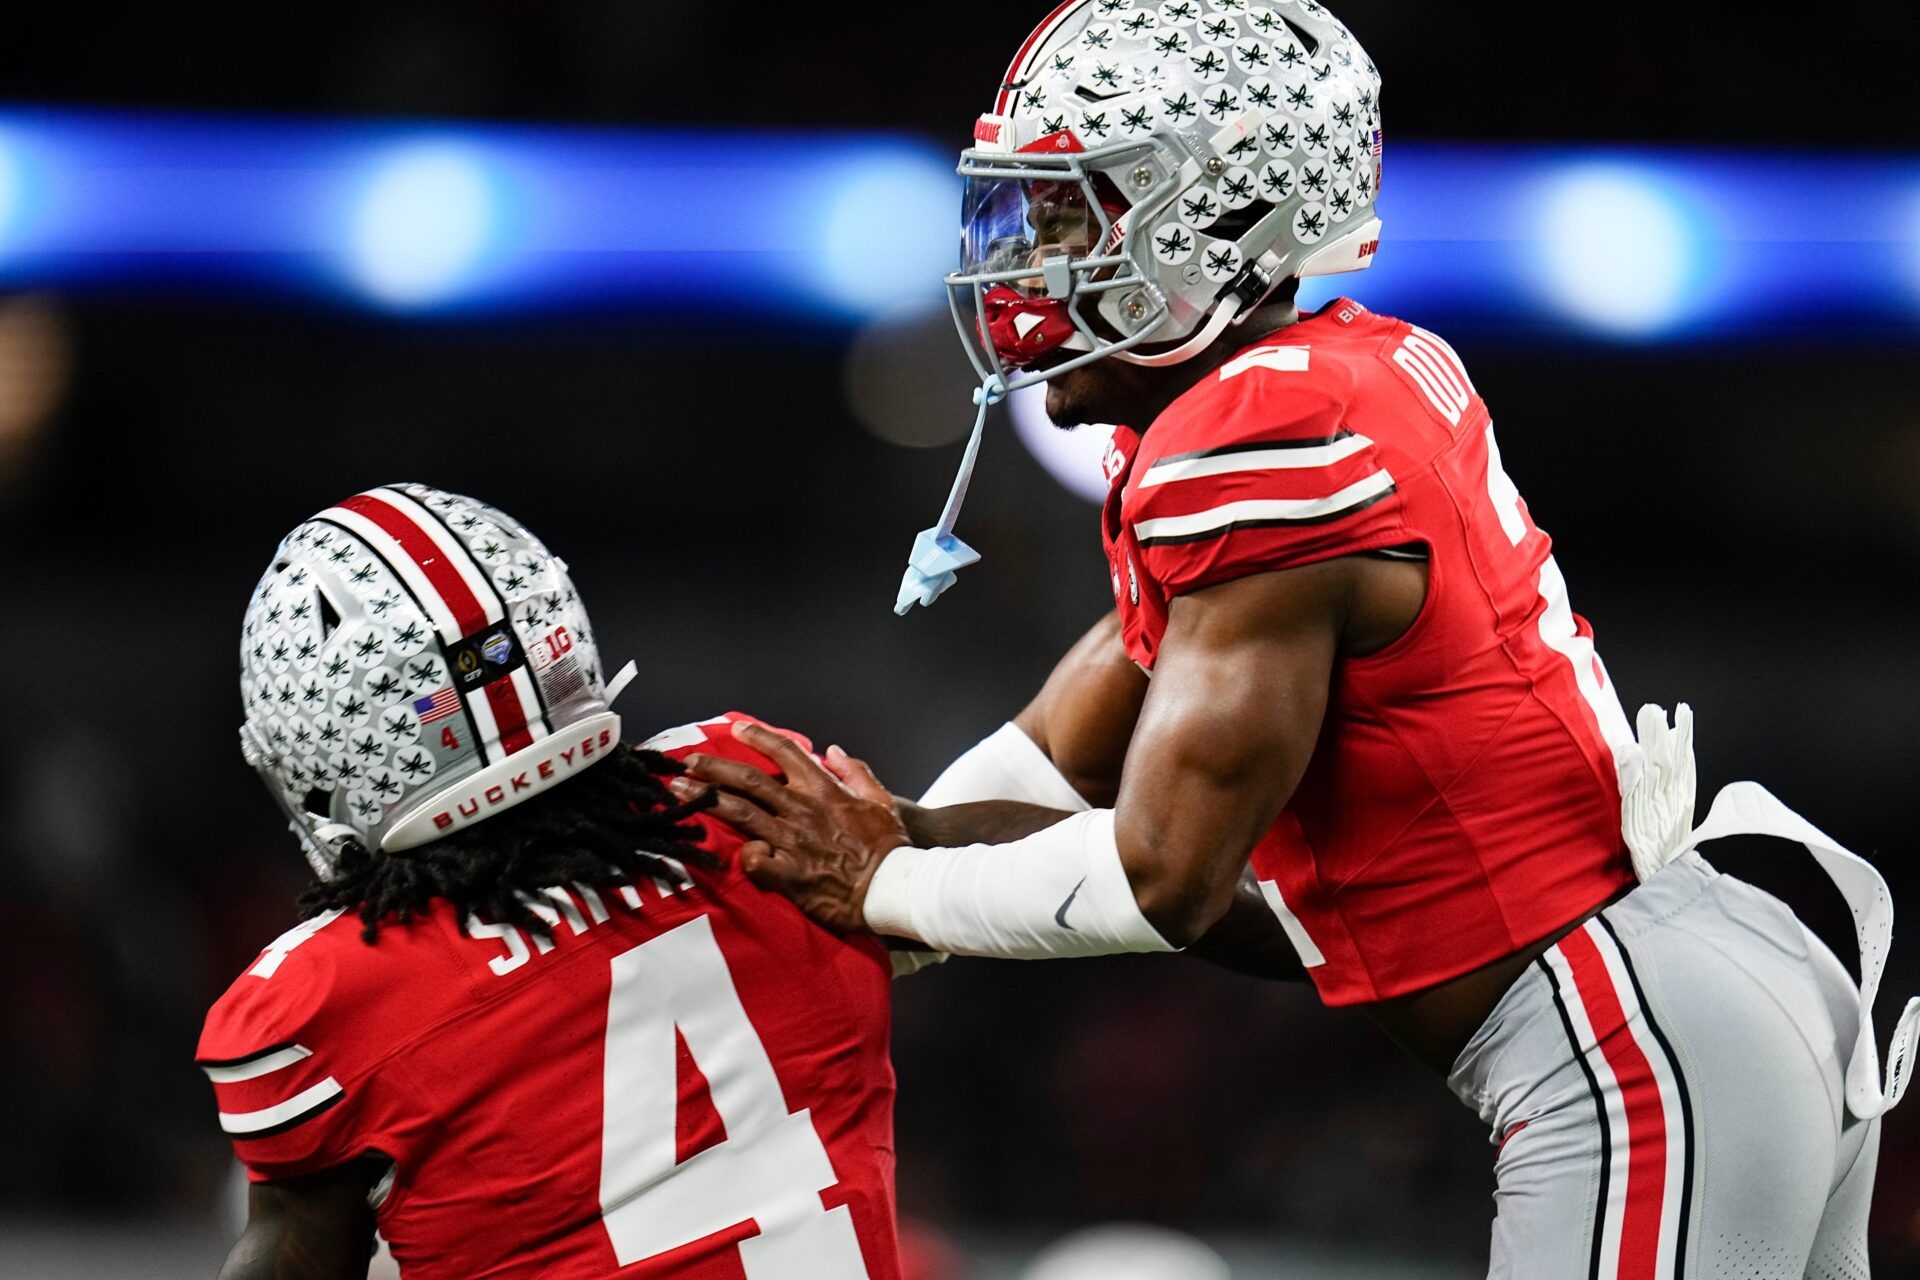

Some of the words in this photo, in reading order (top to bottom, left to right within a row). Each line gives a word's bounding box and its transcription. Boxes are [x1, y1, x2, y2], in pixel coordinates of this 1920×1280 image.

[431, 728, 612, 831] BUCKEYES
[441, 726, 460, 750] 4
[598, 913, 870, 1280] 4
